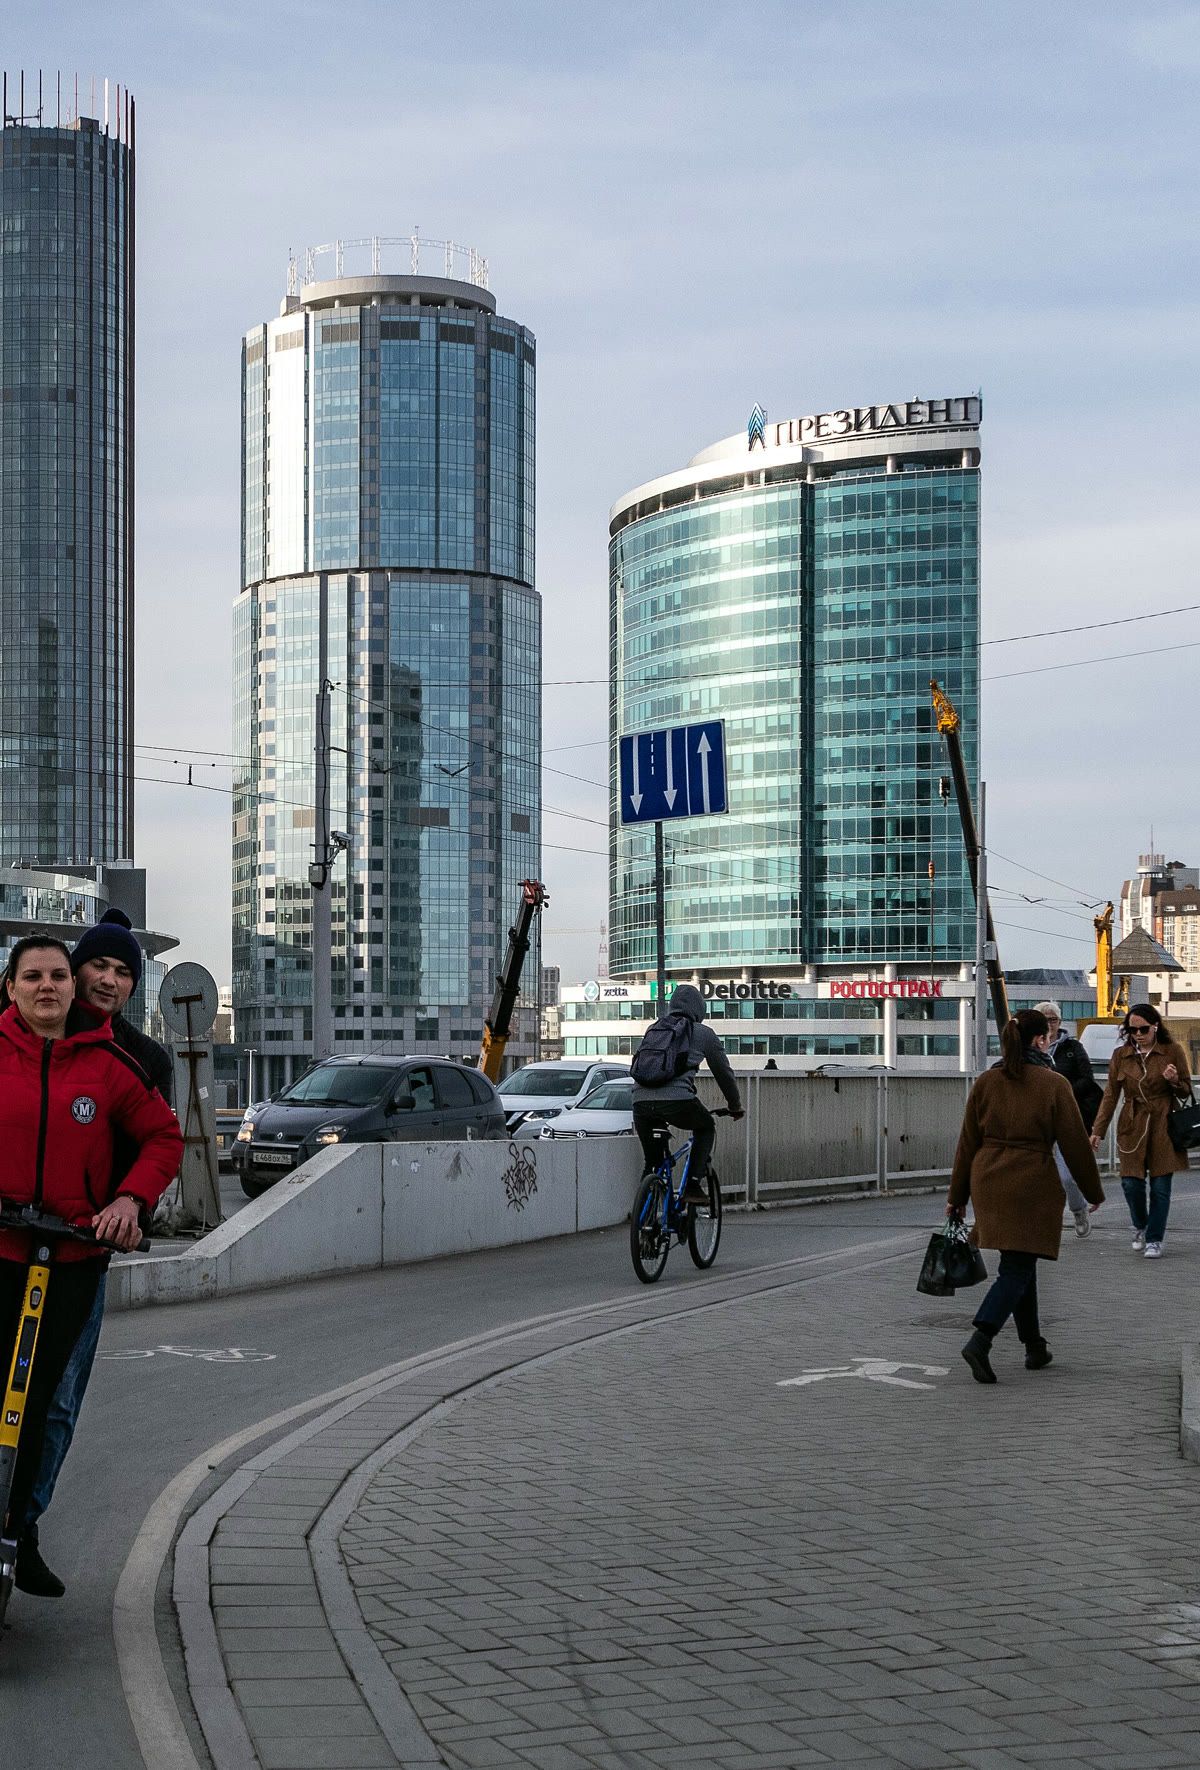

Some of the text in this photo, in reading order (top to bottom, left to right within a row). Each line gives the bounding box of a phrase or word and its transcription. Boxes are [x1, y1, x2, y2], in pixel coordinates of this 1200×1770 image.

[774, 397, 979, 446] ПРЕЗИДЕНТ
[604, 987, 629, 997] zetta
[830, 980, 942, 998] РОСГОССТРАХ
[79, 1103, 90, 1115] M
[7, 1412, 19, 1424] W
